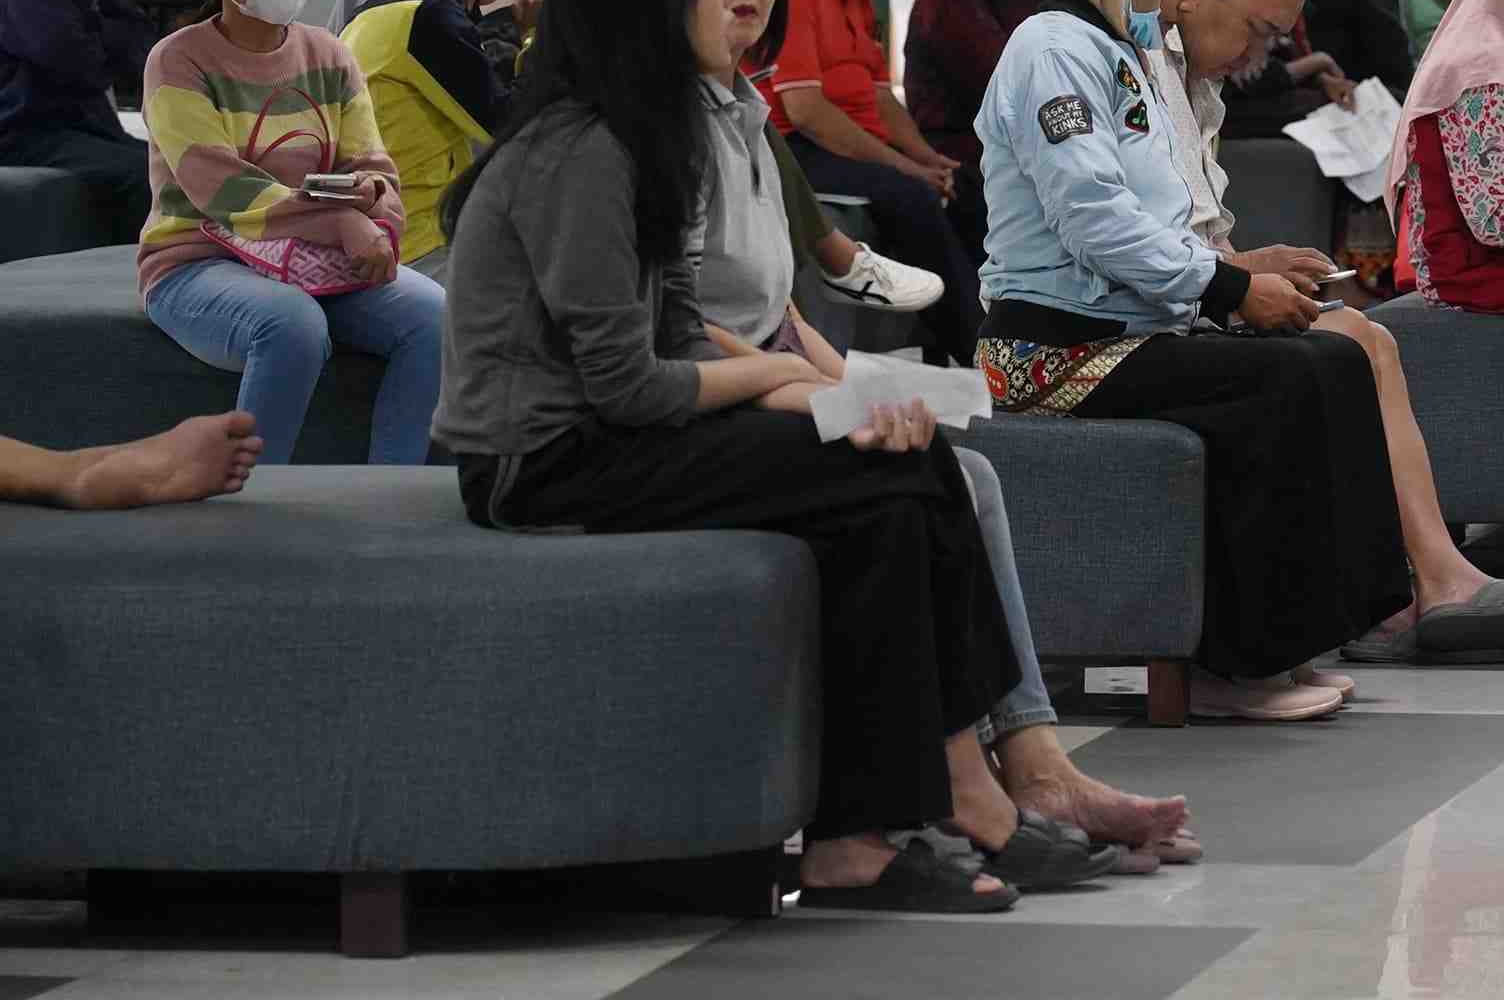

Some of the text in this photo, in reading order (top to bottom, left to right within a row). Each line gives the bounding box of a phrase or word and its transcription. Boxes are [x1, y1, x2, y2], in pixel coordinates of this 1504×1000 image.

[1045, 101, 1081, 120] ASK ME
[1051, 117, 1088, 135] KINKS
